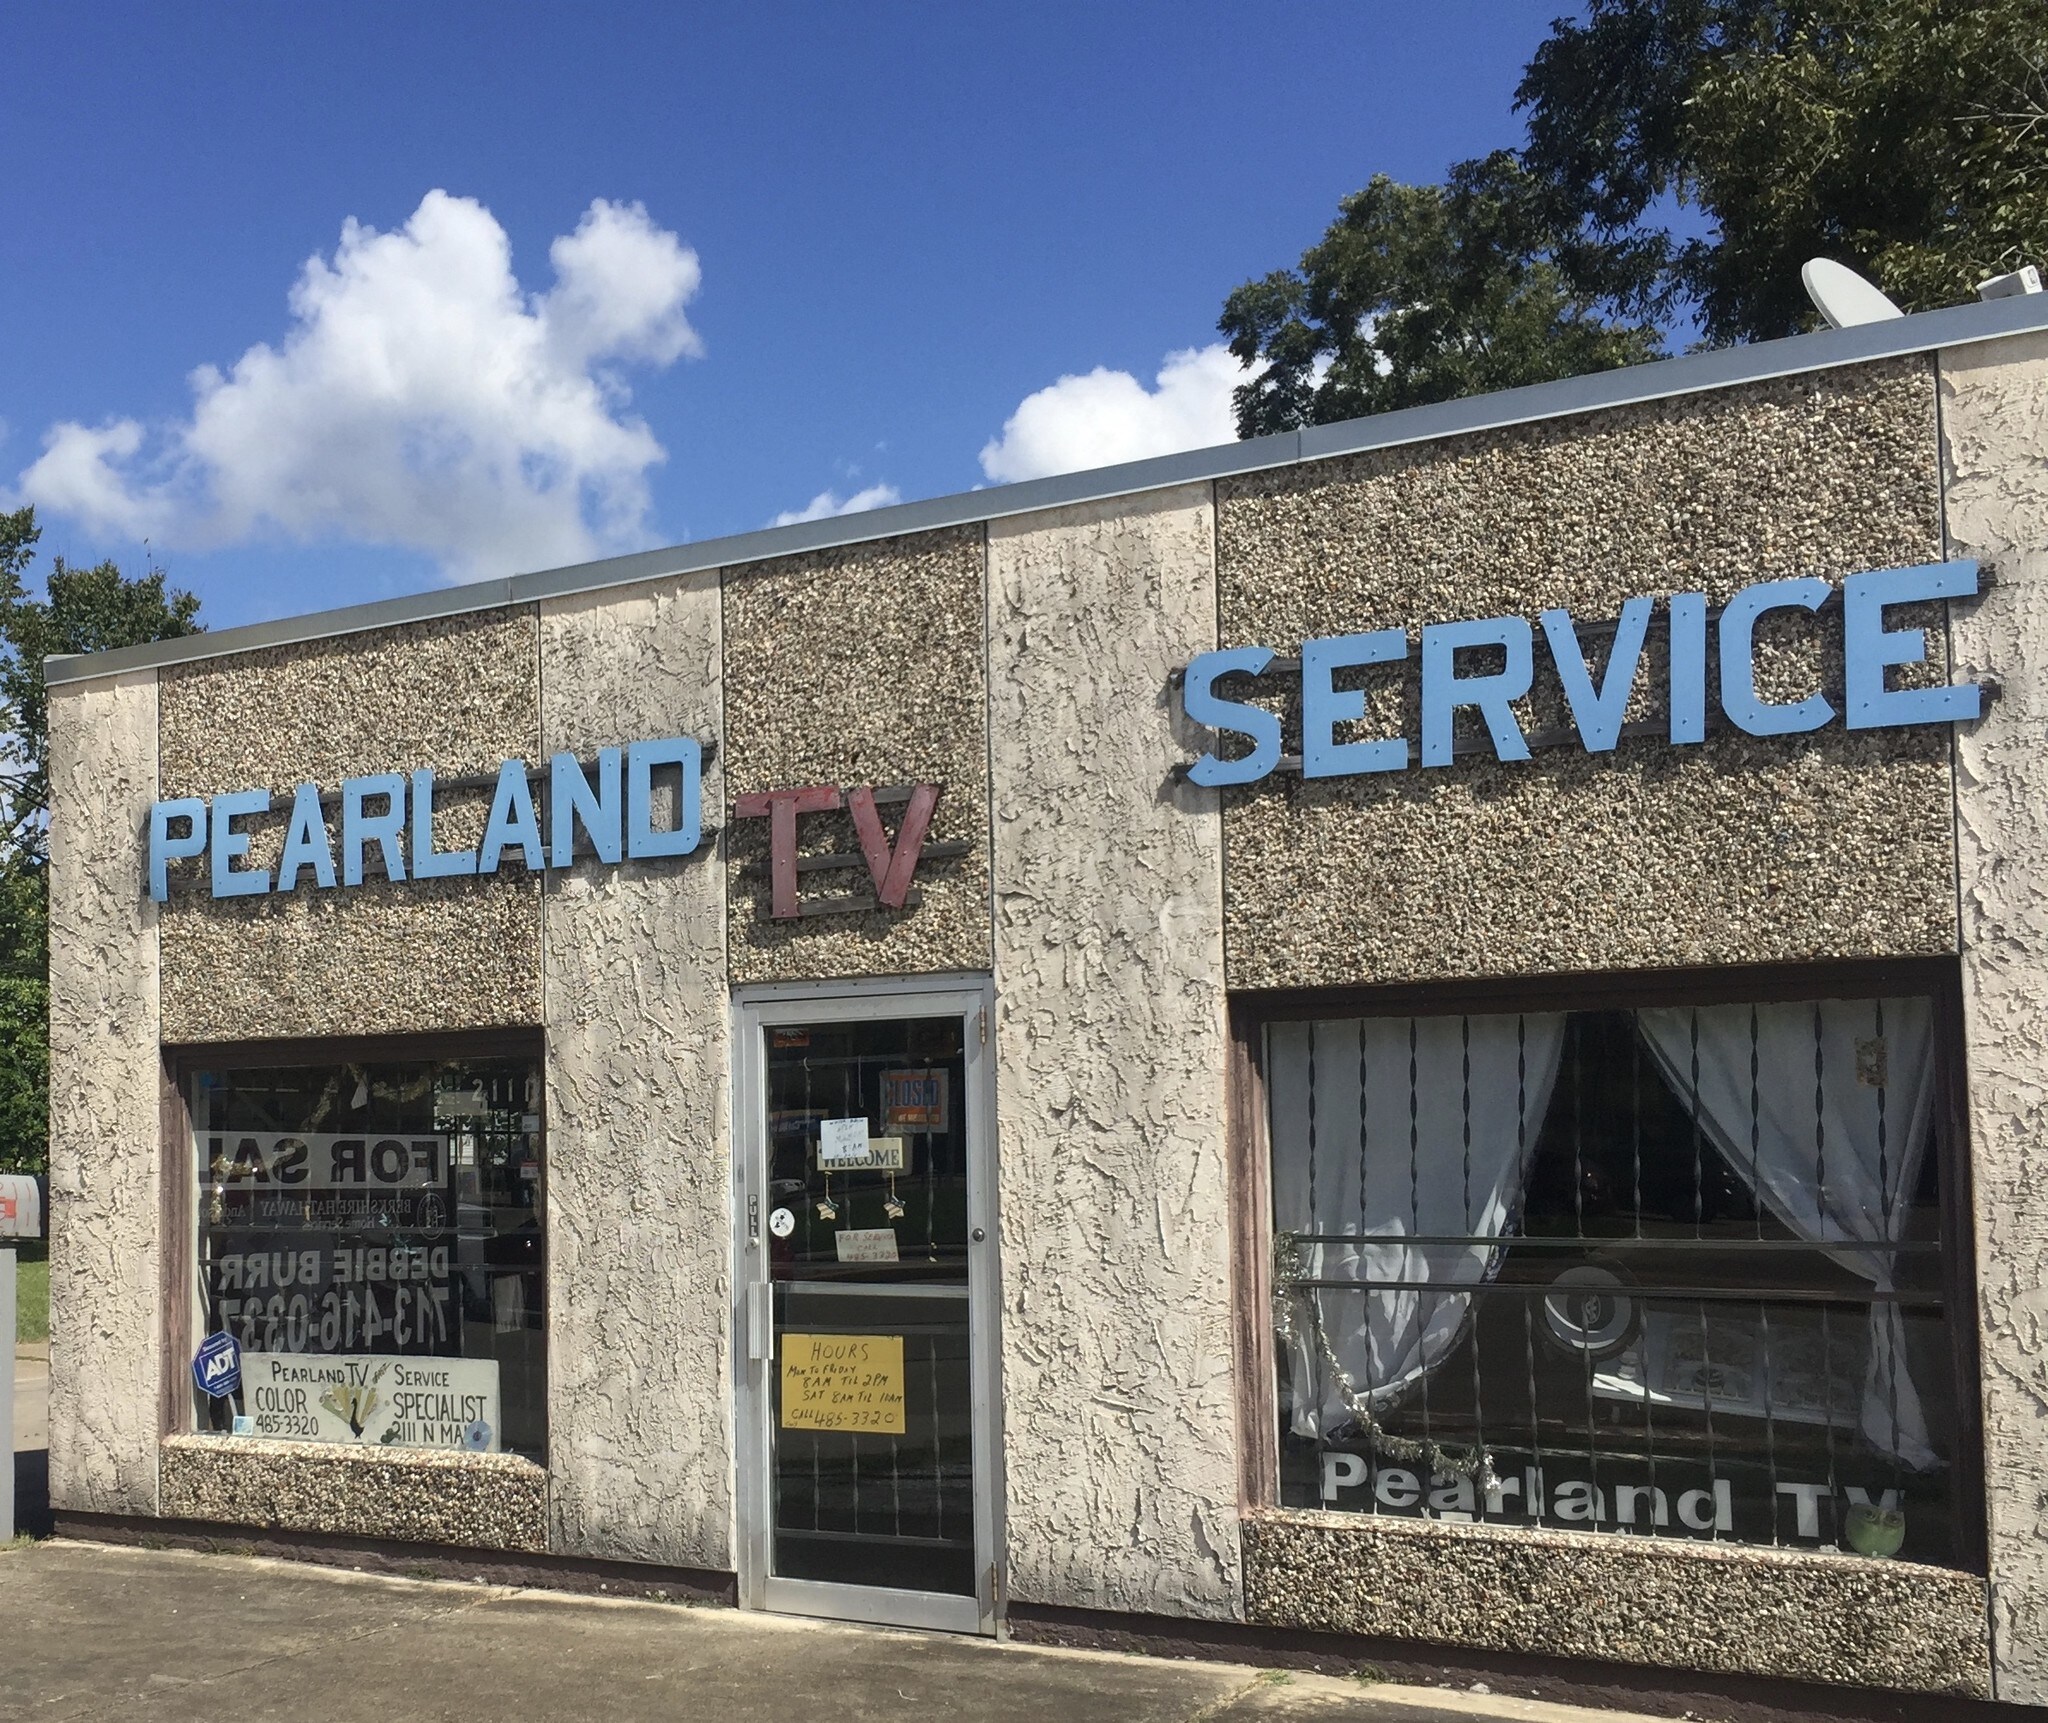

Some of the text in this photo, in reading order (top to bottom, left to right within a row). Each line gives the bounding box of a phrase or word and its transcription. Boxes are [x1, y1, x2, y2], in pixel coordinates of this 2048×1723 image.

[1183, 560, 1981, 787] SERVICE
[149, 736, 940, 919] PEARLAND TV
[472, 1079, 531, 1102] 2111
[749, 1195, 757, 1236] PULL
[206, 1346, 235, 1380] ADT
[811, 1342, 869, 1361] HOURS
[272, 1361, 450, 1387] PEARLAND TV SERVICE
[841, 1375, 859, 1386] TIL
[256, 1386, 487, 1423] COLOR SPECIALIST
[803, 1390, 825, 1401] SAT
[256, 1414, 469, 1445] 485-3320 2111 N MA
[791, 1408, 814, 1421] CALL
[815, 1410, 896, 1428] 485-3320
[1322, 1452, 1733, 1531] Pearland
